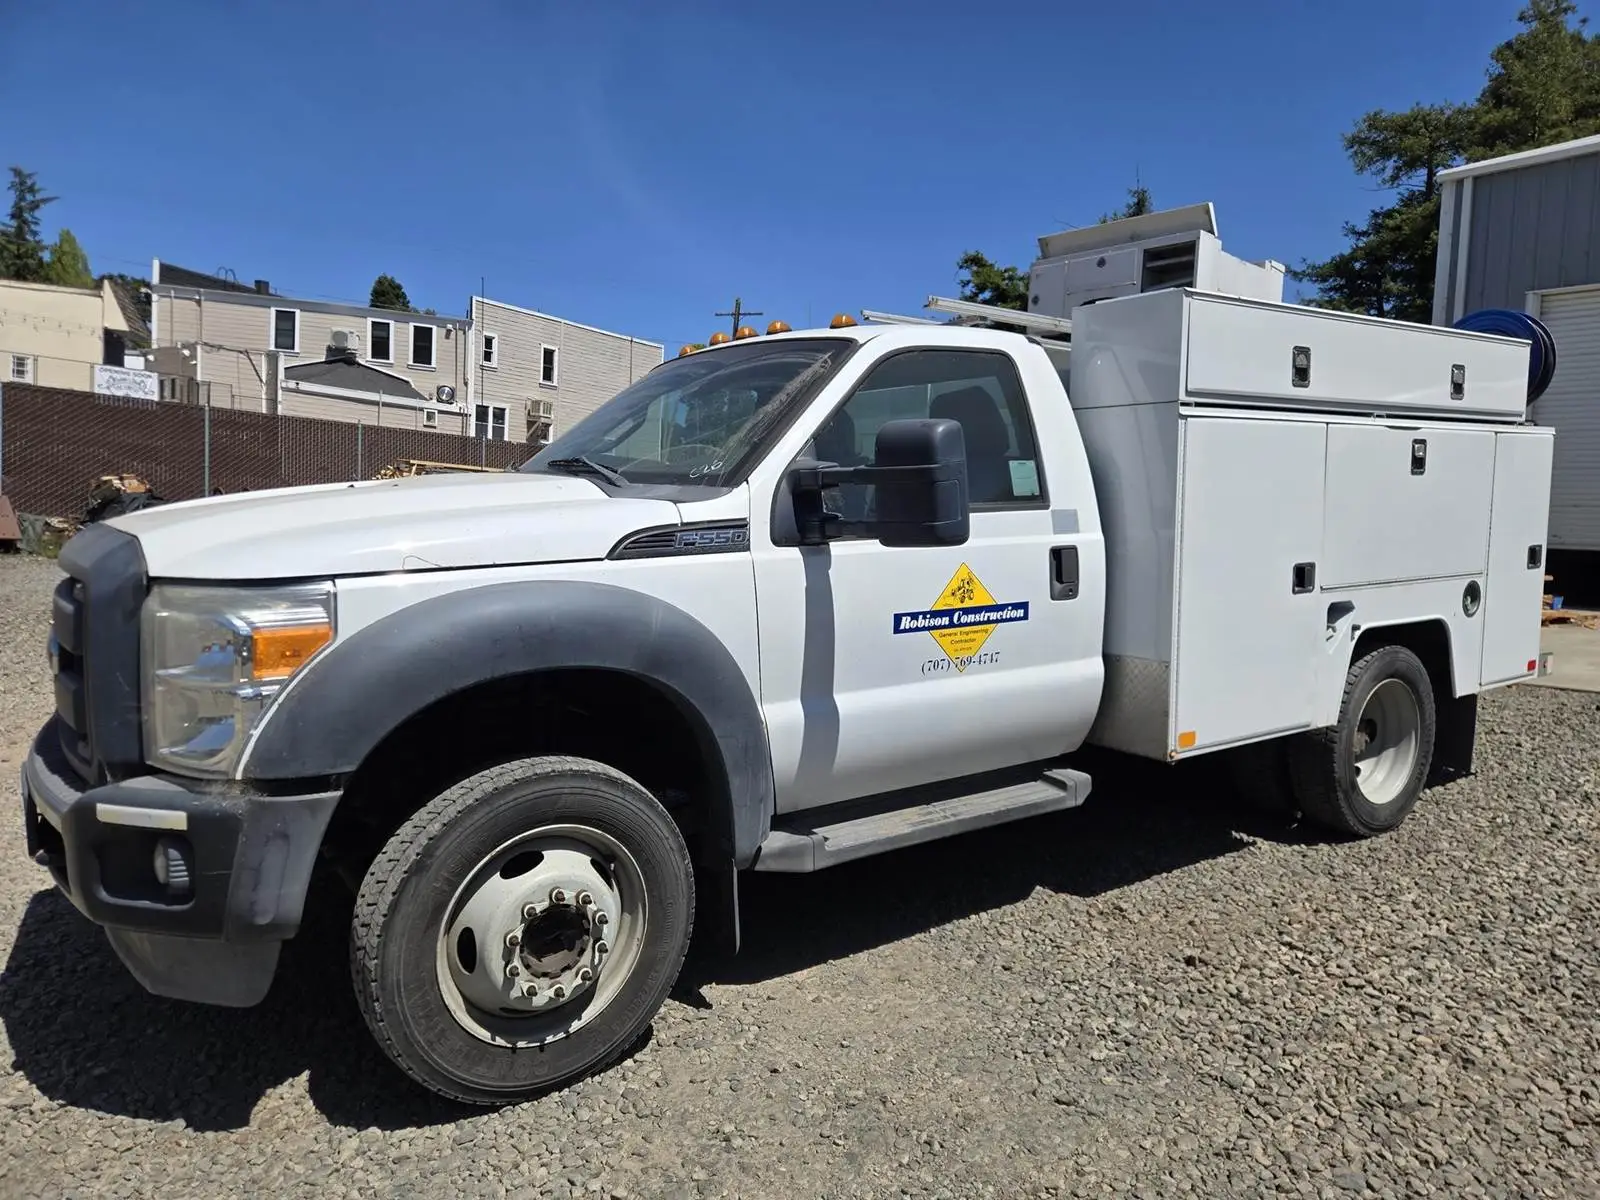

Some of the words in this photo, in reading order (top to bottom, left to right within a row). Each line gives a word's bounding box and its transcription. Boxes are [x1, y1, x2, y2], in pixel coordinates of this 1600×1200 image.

[675, 528, 749, 547] F-550
[899, 614, 950, 630] Robison
[953, 606, 1025, 624] Construction
[959, 628, 989, 636] Engineering
[921, 658, 951, 676] (707)
